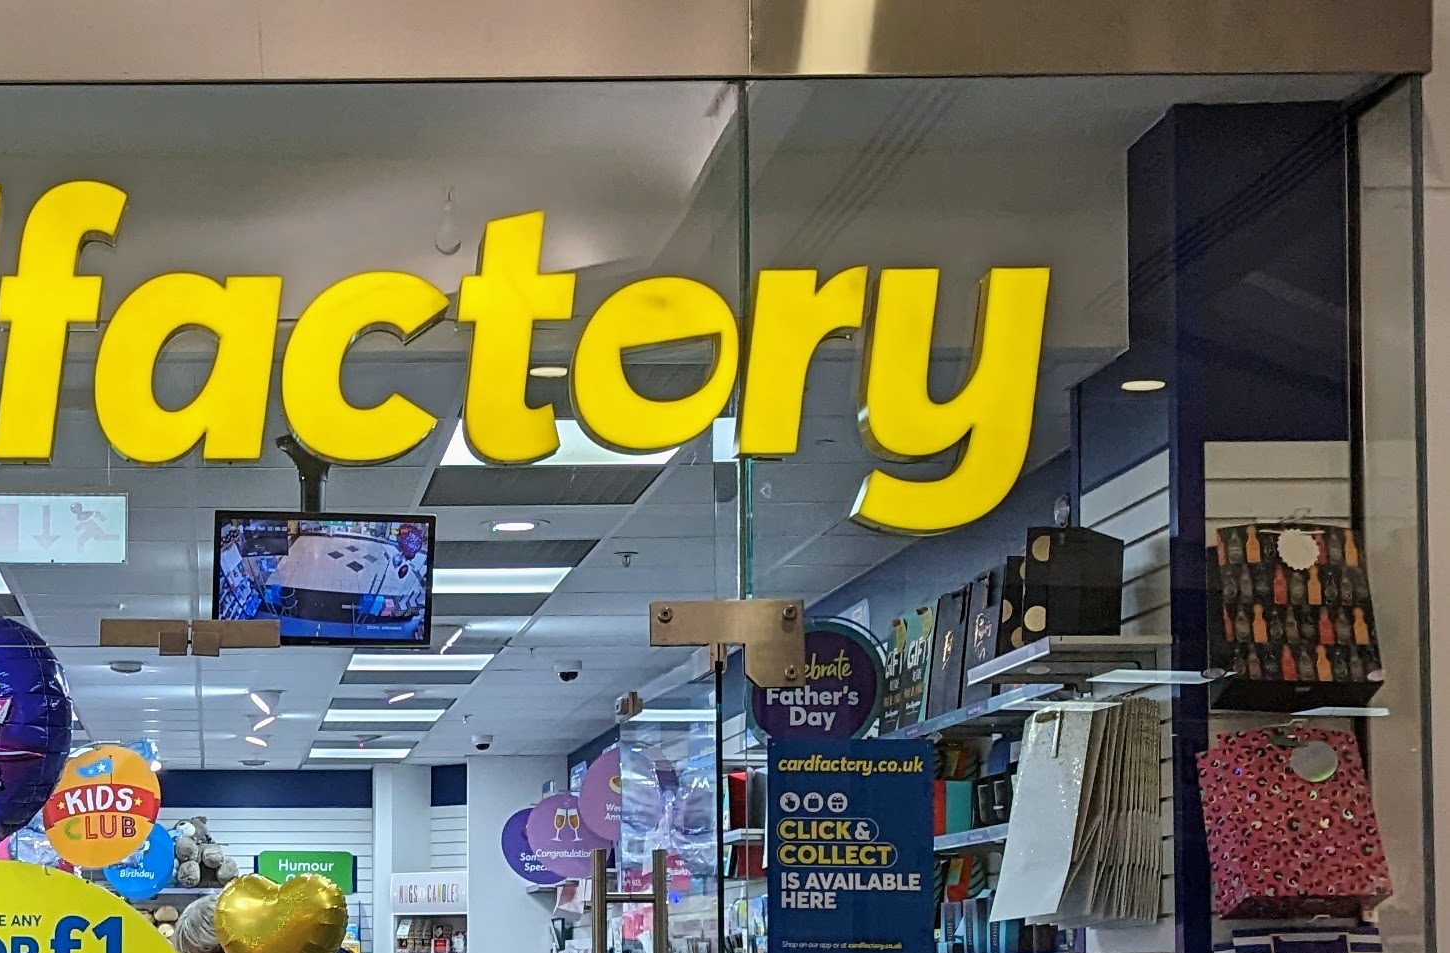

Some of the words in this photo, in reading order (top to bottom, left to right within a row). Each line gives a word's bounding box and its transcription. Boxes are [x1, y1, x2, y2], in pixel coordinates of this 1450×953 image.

[804, 649, 853, 681] ebrate
[766, 686, 860, 706] Father's
[789, 707, 837, 731] Day
[778, 755, 923, 776] cardfactory.co.uk
[64, 785, 134, 815] KIDS
[64, 815, 137, 840] CLUB
[779, 821, 852, 840] CLICK
[854, 821, 870, 841] &
[779, 844, 892, 865] COLLECT
[120, 869, 155, 881] Birthday
[278, 859, 335, 873] Humour
[781, 872, 800, 889] IS
[805, 873, 921, 891] AVAILABLE
[781, 891, 837, 909] HERE
[10, 914, 42, 927] ANY
[782, 940, 799, 949] Shop
